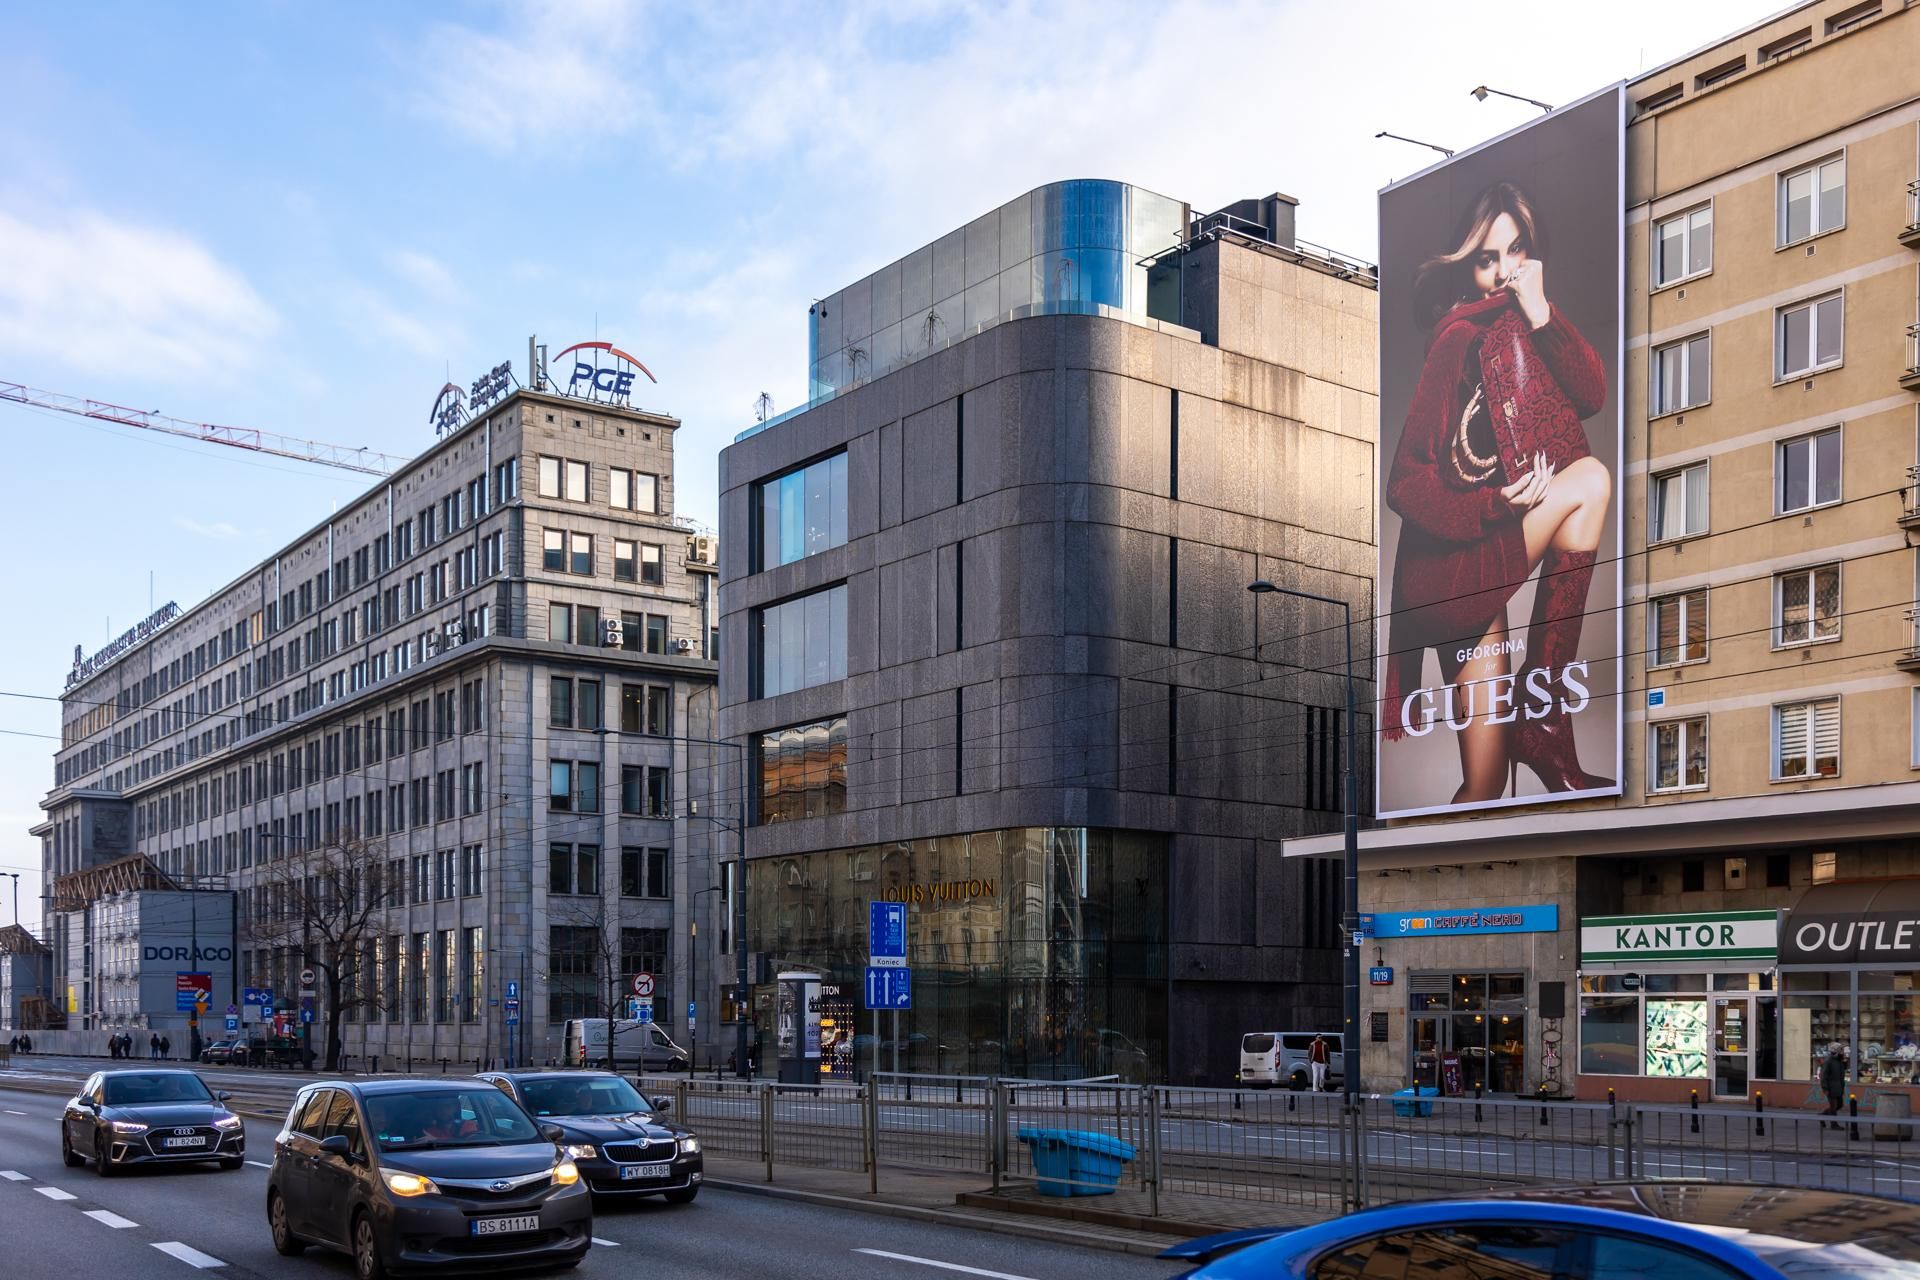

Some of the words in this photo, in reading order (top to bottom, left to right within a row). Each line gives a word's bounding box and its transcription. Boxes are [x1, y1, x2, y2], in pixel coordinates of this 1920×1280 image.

[570, 362, 636, 396] PGE
[1456, 638, 1525, 663] GEORGINA
[1484, 662, 1498, 673] for
[1401, 659, 1590, 737] GUESS
[881, 882, 924, 904] LOUIS
[928, 878, 997, 902] VUITTON
[1481, 913, 1523, 928] NERO
[1616, 925, 1736, 949] KANTOR
[1795, 920, 1920, 952] OUTLE
[144, 946, 232, 961] DORACO
[1373, 971, 1388, 981] 11/19
[264, 1007, 271, 1016] P
[228, 1020, 235, 1028] P
[627, 1167, 639, 1177] WY
[642, 1165, 669, 1176] 0818H
[479, 1220, 496, 1233] BS
[500, 1217, 536, 1232] 8111A
